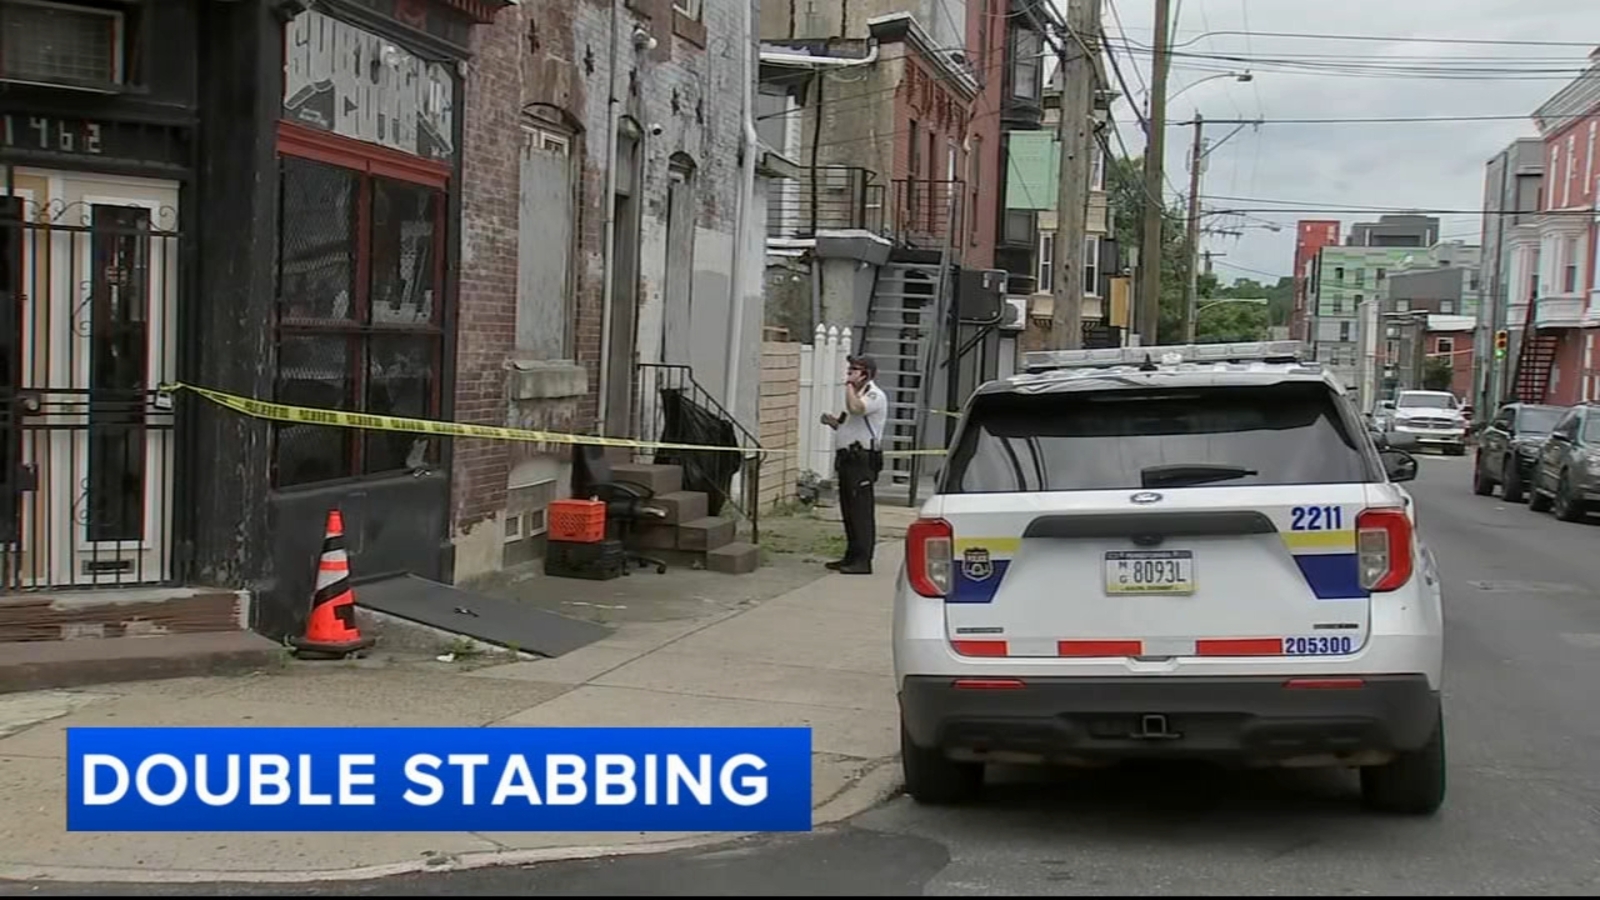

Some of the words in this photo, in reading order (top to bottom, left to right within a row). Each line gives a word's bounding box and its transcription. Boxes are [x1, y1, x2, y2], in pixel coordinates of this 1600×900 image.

[4, 114, 102, 154] 1462
[1290, 505, 1342, 531] 2211
[1133, 560, 1187, 584] 8093L
[1284, 636, 1352, 654] 205300
